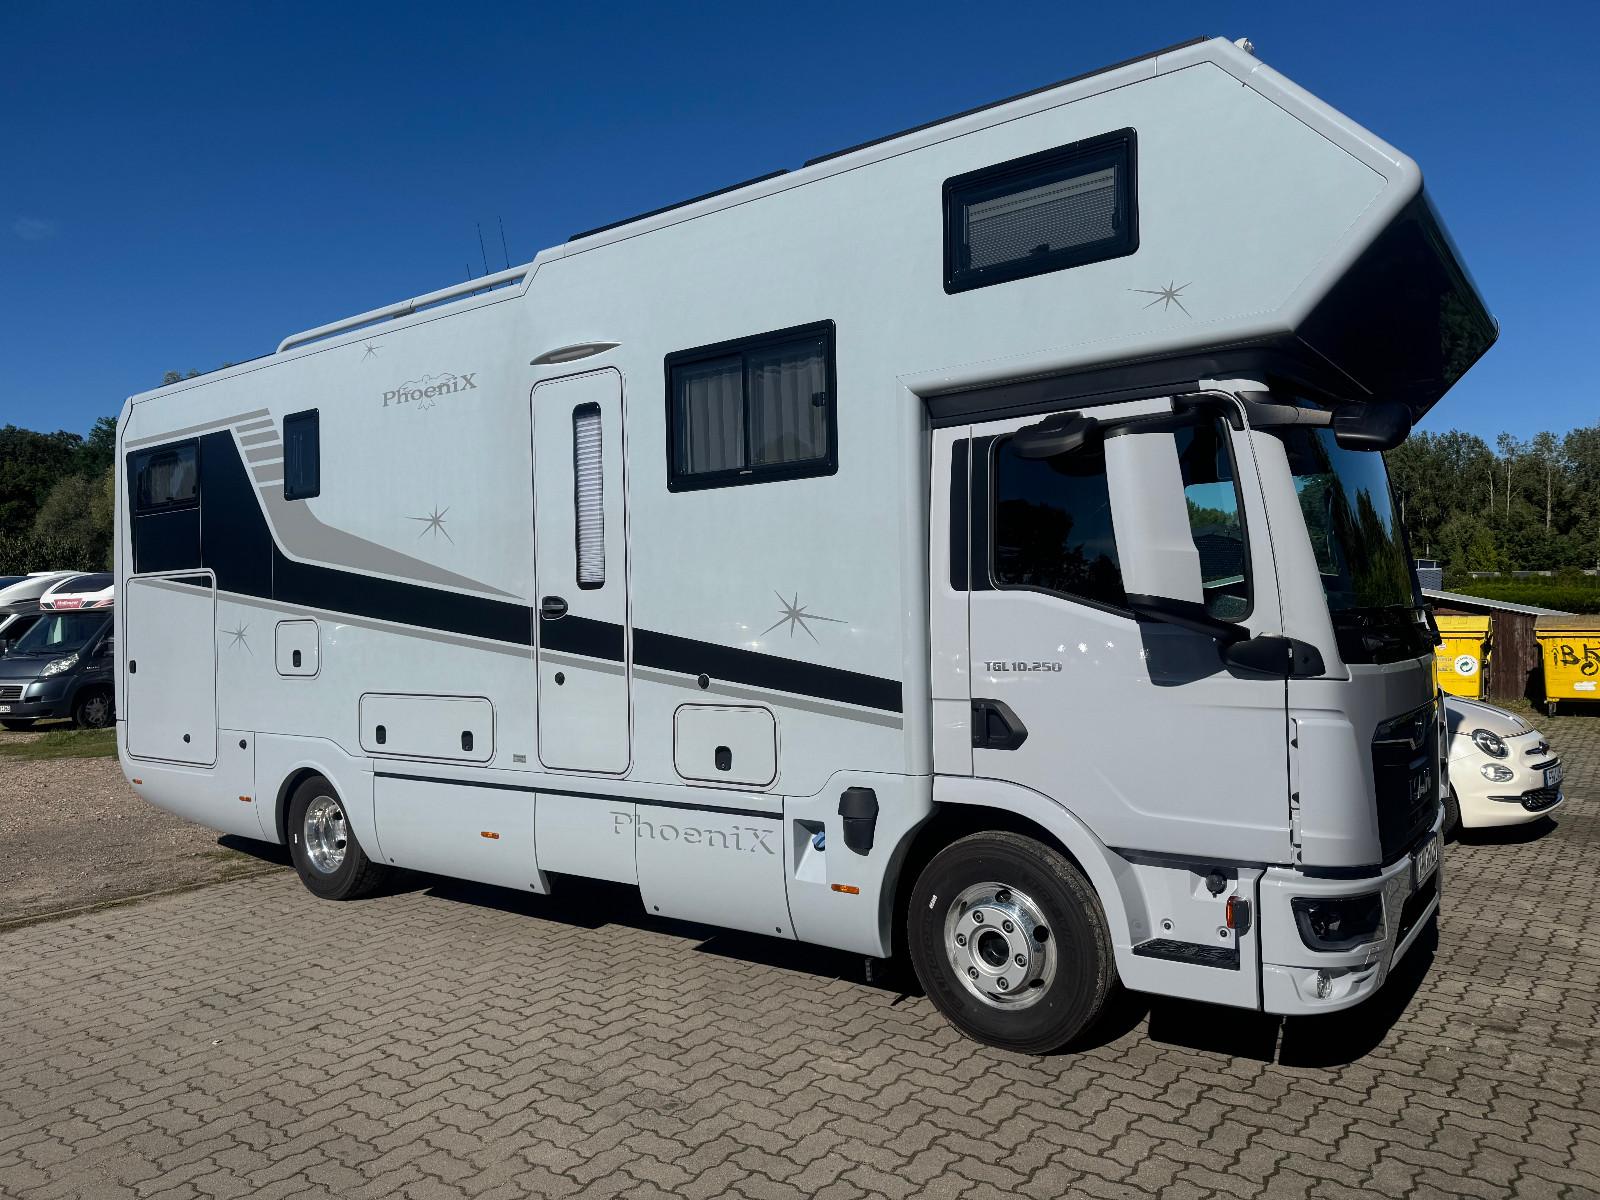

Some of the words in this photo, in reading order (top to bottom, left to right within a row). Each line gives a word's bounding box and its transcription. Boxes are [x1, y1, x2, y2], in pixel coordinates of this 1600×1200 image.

[382, 372, 478, 407] PhoeniX
[984, 661, 1010, 672] TGL
[1011, 661, 1063, 673] 10.250
[609, 811, 775, 855] PhoeniX
